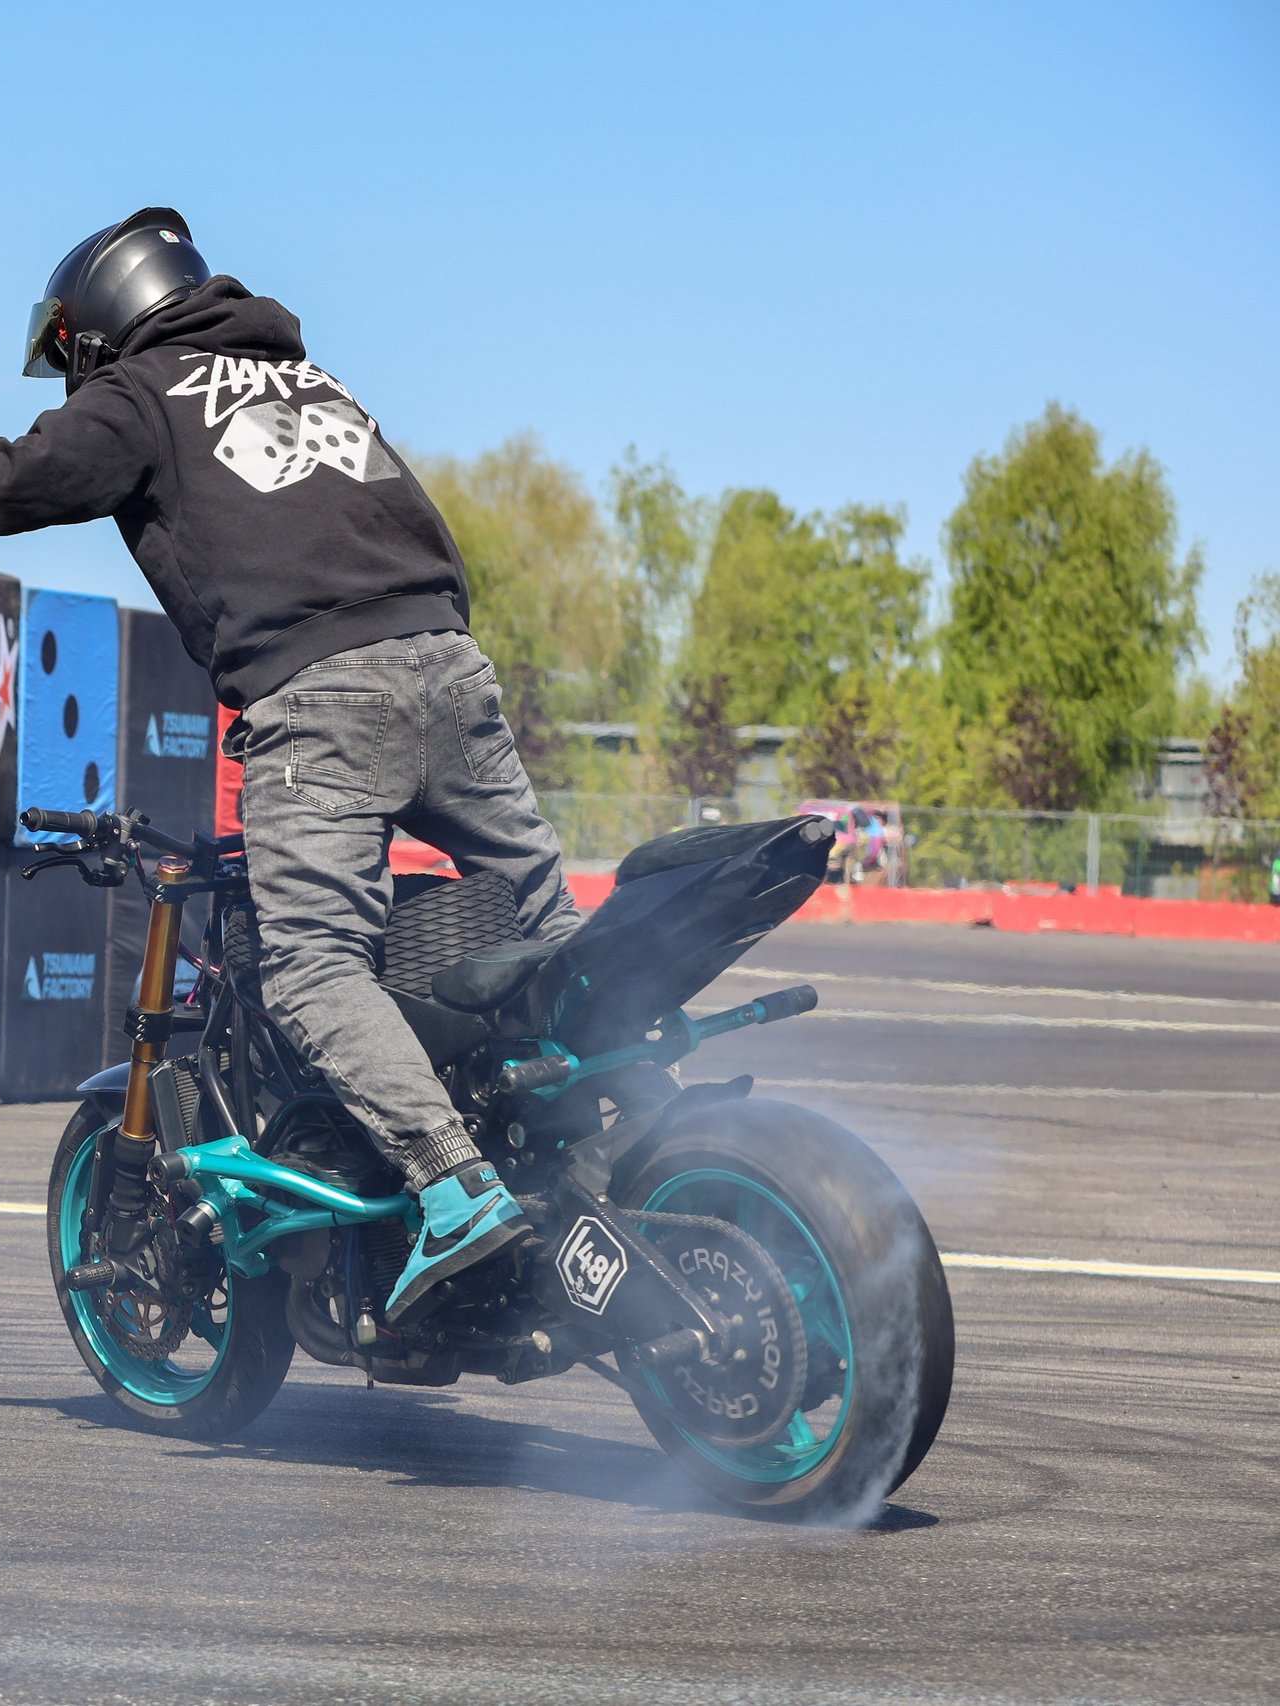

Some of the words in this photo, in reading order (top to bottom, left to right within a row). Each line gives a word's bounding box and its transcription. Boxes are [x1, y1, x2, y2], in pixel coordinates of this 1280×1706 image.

[162, 712, 210, 736] TSUNAMI
[161, 735, 208, 759] FACTORY
[43, 953, 96, 975] TSUNAMI
[42, 976, 95, 999] FACTORY
[679, 1248, 763, 1303] CRAZY
